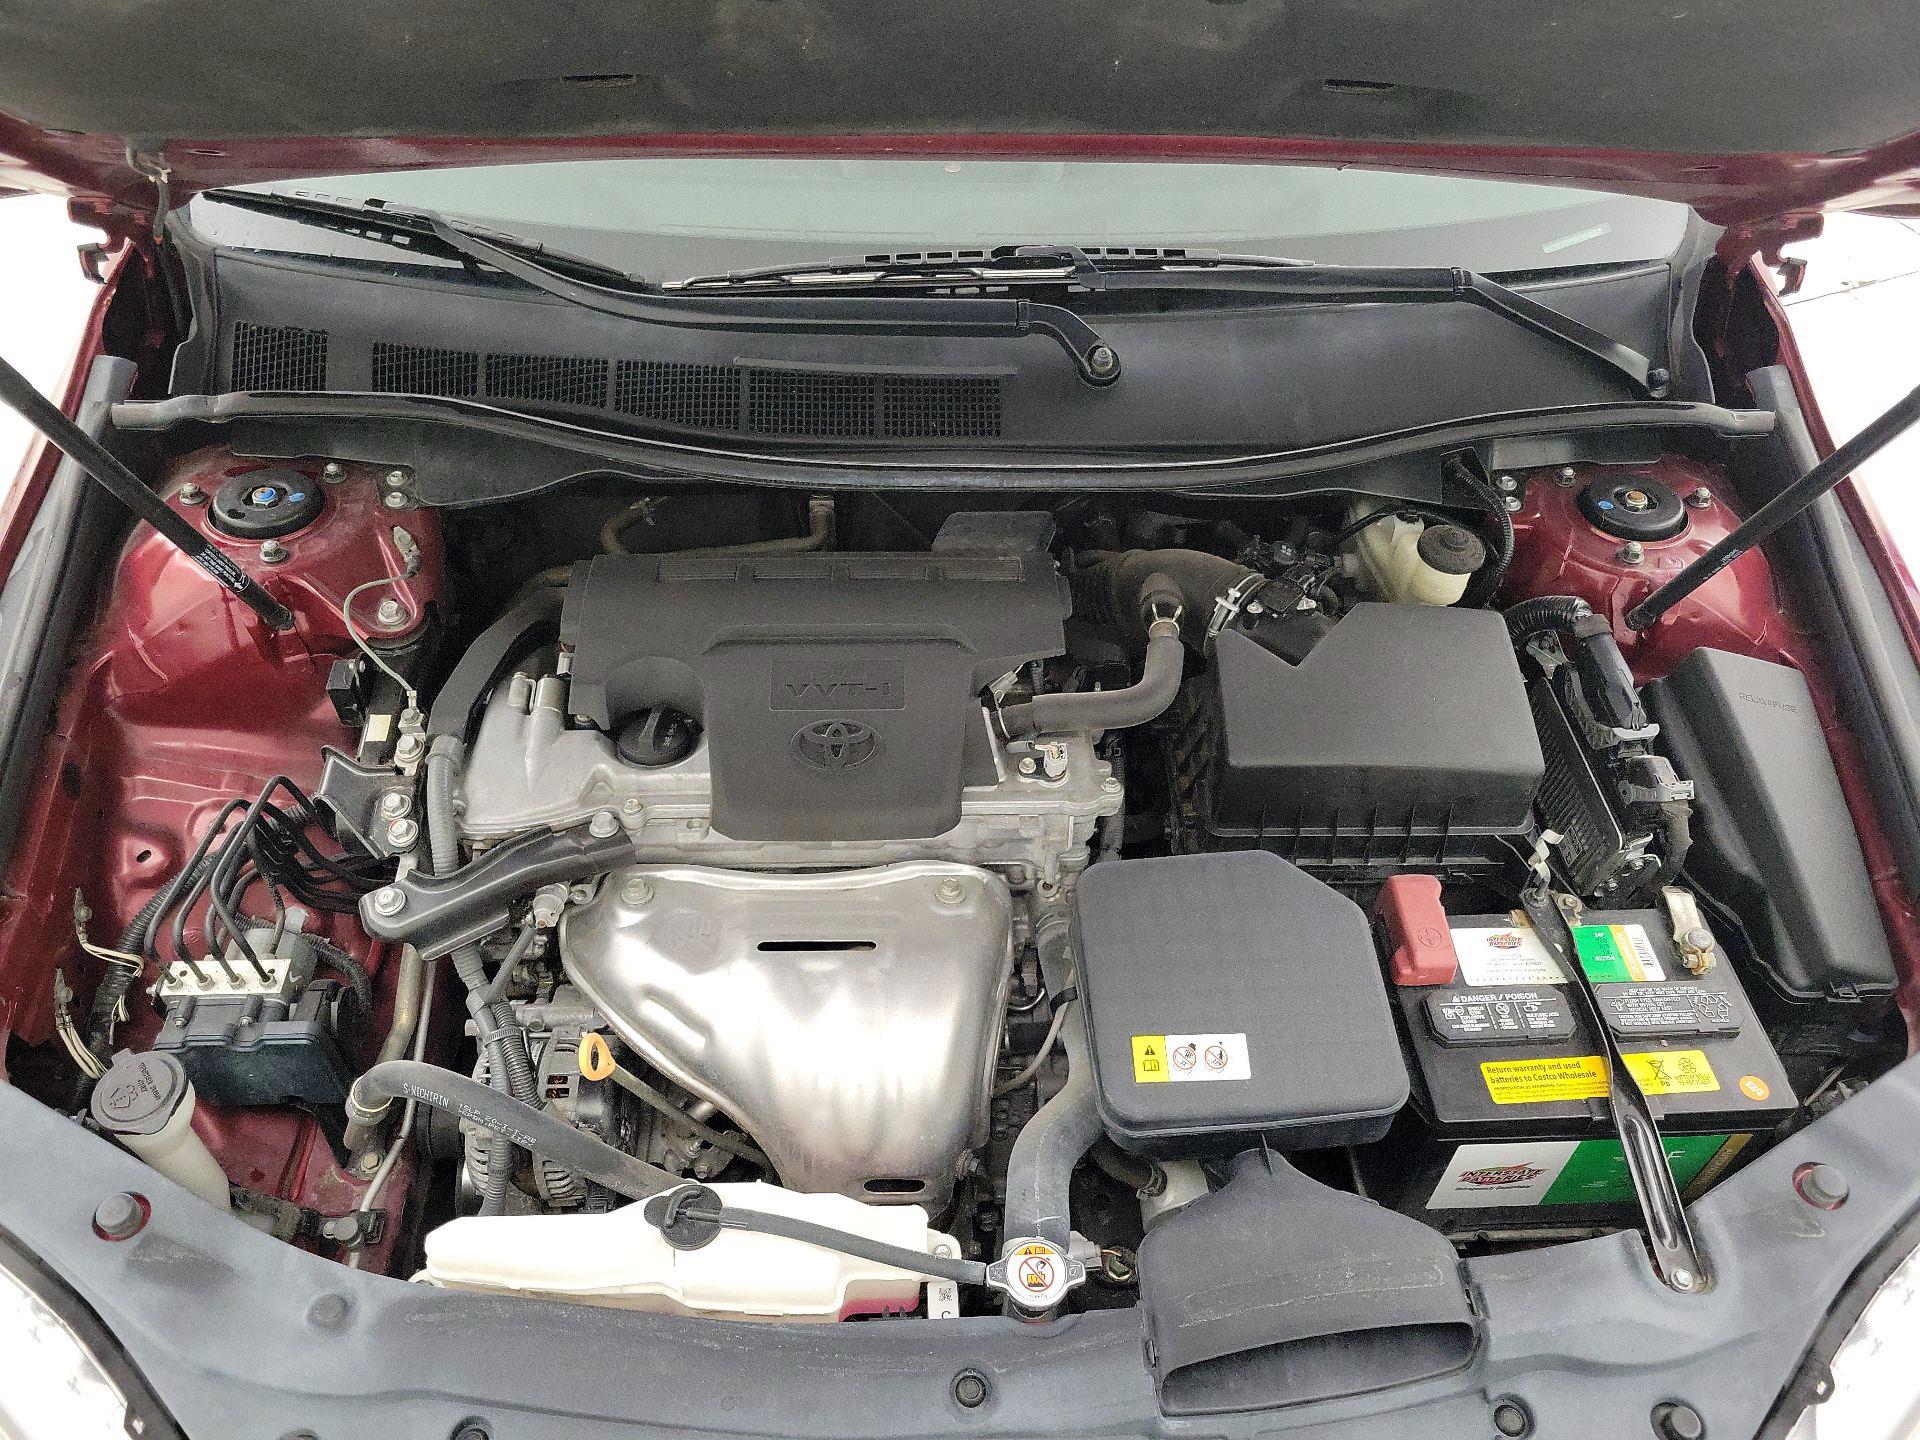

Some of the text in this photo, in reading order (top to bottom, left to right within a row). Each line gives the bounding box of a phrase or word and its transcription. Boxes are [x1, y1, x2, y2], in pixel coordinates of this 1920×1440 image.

[1462, 994, 1498, 1003] DANGER
[1504, 992, 1538, 1001] POISON
[1486, 1060, 1581, 1074] Return warranty and used
[1490, 1076, 1523, 1084] batteries
[1532, 1073, 1557, 1082] Costco
[1558, 1070, 1598, 1080] Wholesale
[1458, 1173, 1537, 1182] BATTERIES
[1460, 1168, 1549, 1178] INTERSTATE
